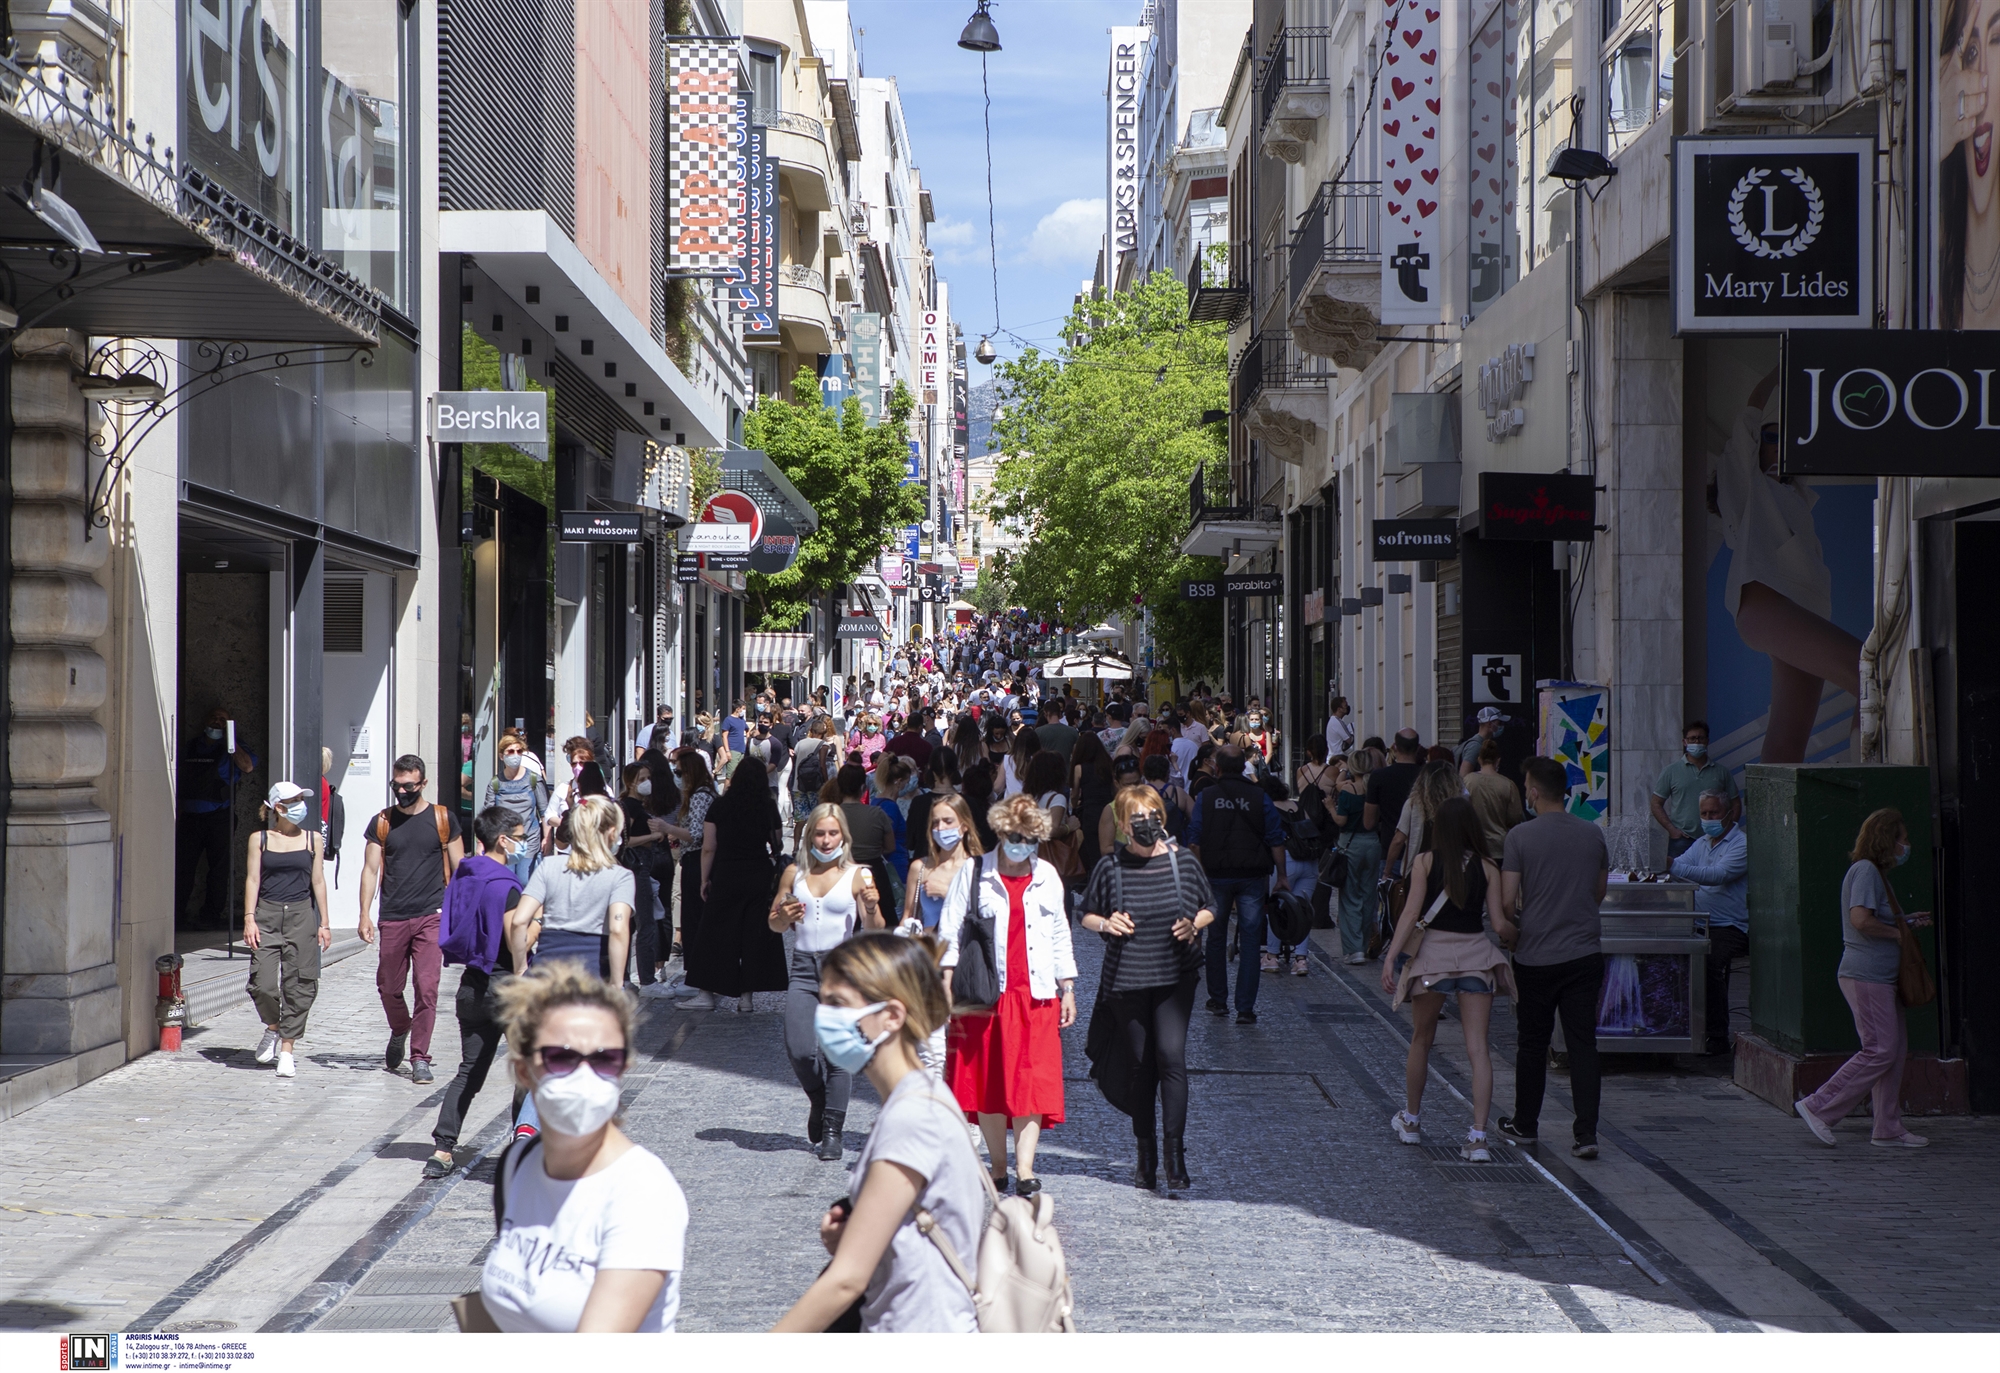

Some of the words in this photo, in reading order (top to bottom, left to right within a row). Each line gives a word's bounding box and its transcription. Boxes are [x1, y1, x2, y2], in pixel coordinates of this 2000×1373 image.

[1117, 43, 1136, 161] SPENCER
[677, 70, 734, 253] POP-AIR
[1117, 163, 1135, 179] &
[1117, 184, 1135, 256] ARKS
[1704, 273, 1774, 303] Mary
[1781, 271, 1849, 298] Lides
[437, 404, 540, 430] Bershka
[564, 527, 585, 535] MAKI
[588, 527, 638, 535] PHILOSOPHY
[685, 526, 742, 541] manouka
[1378, 531, 1452, 546] sofronas
[763, 535, 796, 545] INTER
[763, 545, 796, 554] SPORT
[1188, 584, 1216, 597] BSB
[1227, 580, 1271, 592] parabita
[837, 623, 878, 632] ROMANO
